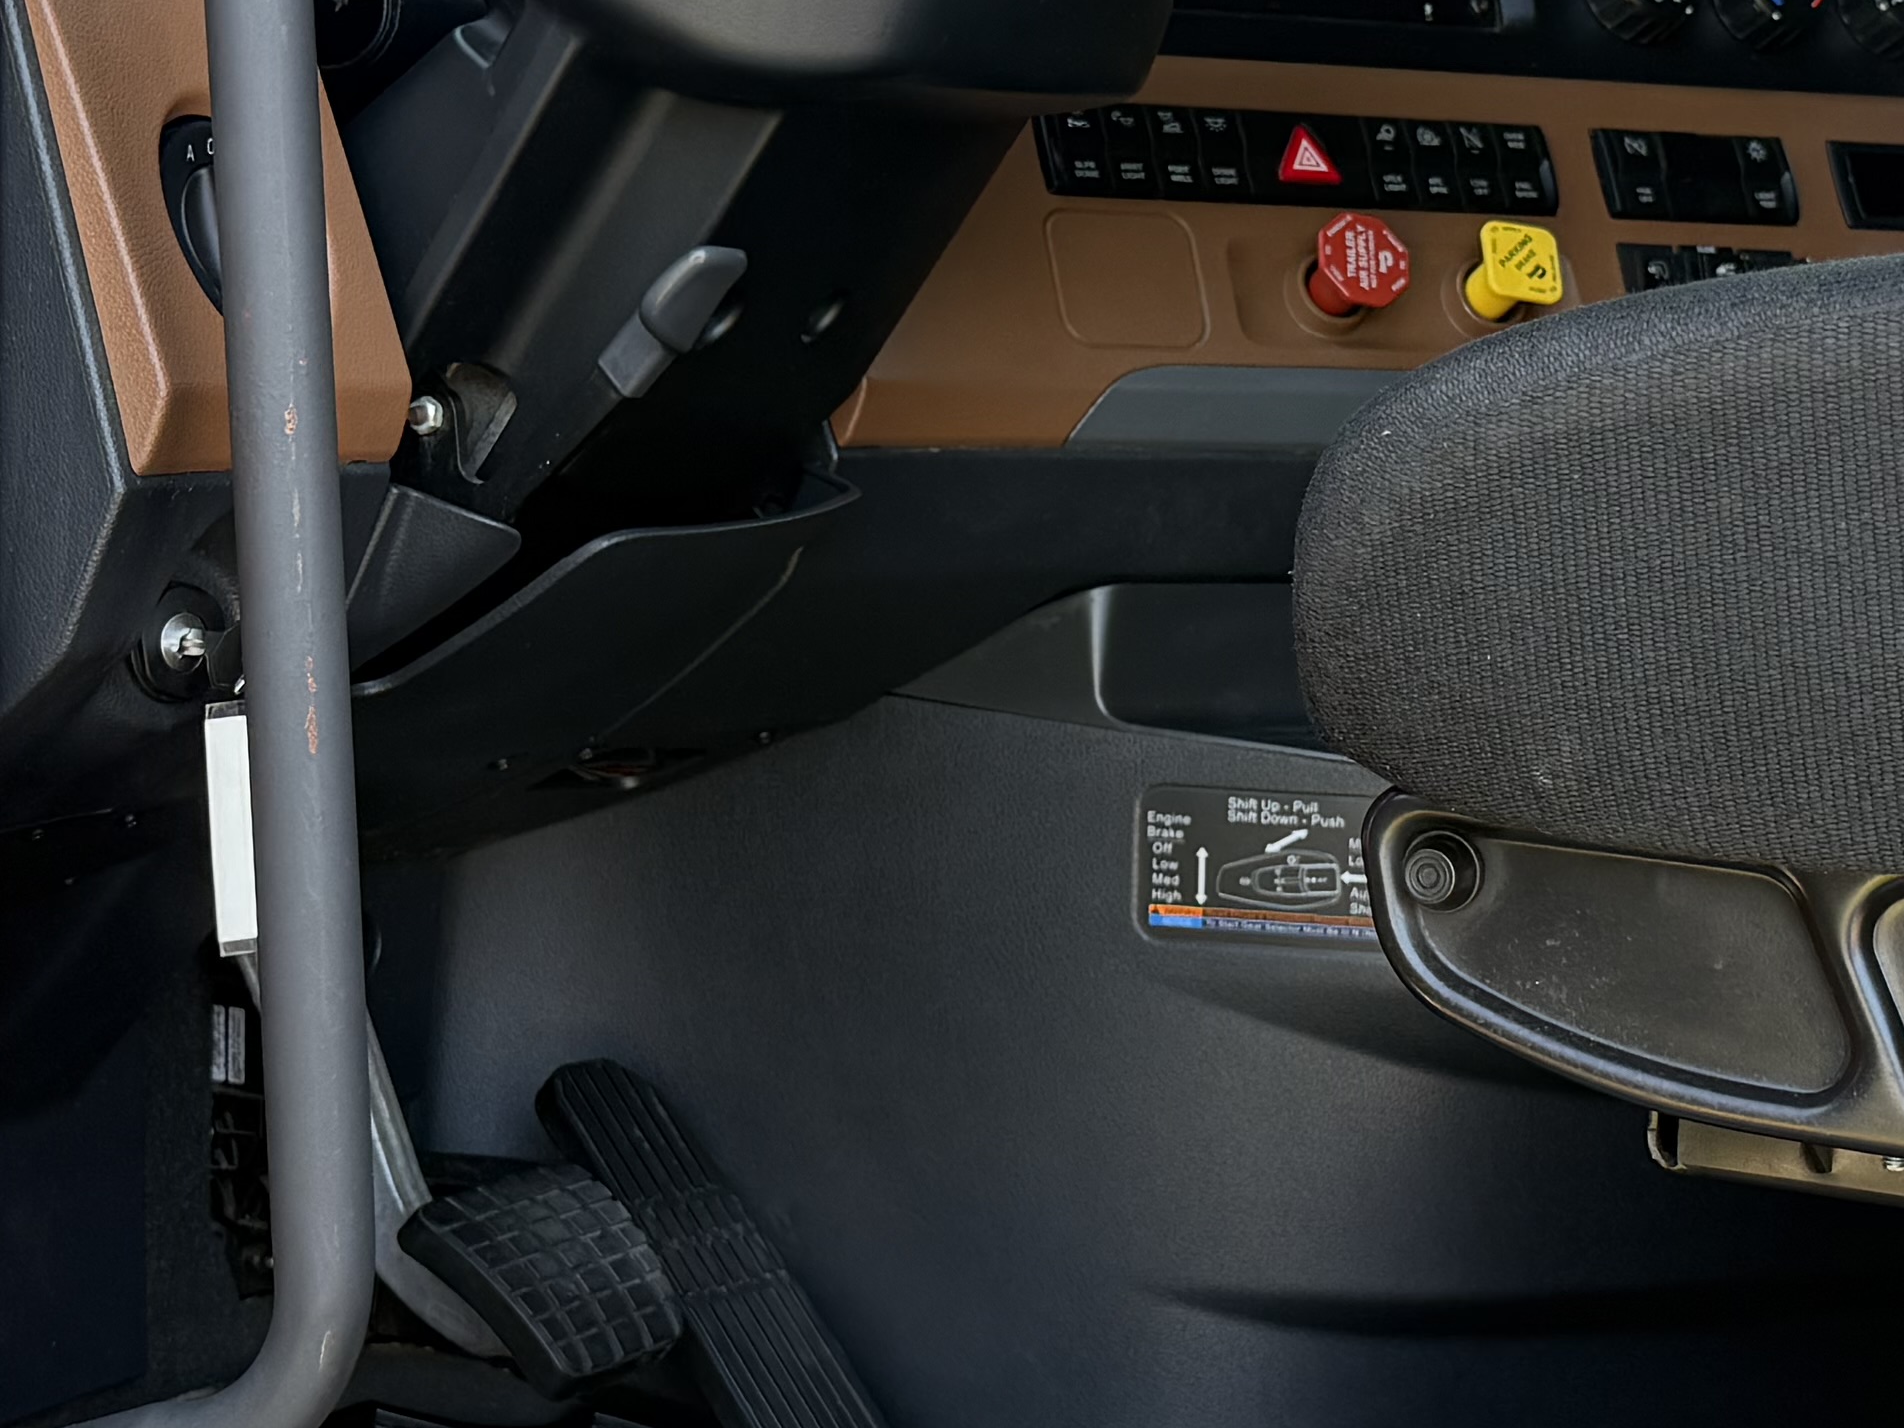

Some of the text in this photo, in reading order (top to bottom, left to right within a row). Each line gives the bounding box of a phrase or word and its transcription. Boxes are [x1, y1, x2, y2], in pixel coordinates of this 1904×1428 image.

[186, 143, 195, 162] A
[1345, 230, 1356, 278] TRAILER
[1356, 223, 1370, 291] AIR SUPPLY
[1498, 233, 1533, 268] PARKING
[1227, 796, 1258, 812] Shift
[1261, 798, 1280, 814] Up
[1292, 800, 1318, 813] Pull
[1147, 810, 1192, 826] Engine
[1227, 810, 1258, 824] Shift
[1260, 811, 1299, 825] Down
[1310, 814, 1345, 829] Push
[1147, 825, 1184, 839] Brake
[1152, 841, 1173, 854] Off
[1152, 858, 1179, 871] Low
[1152, 873, 1180, 886] Med
[1152, 888, 1182, 904] High
